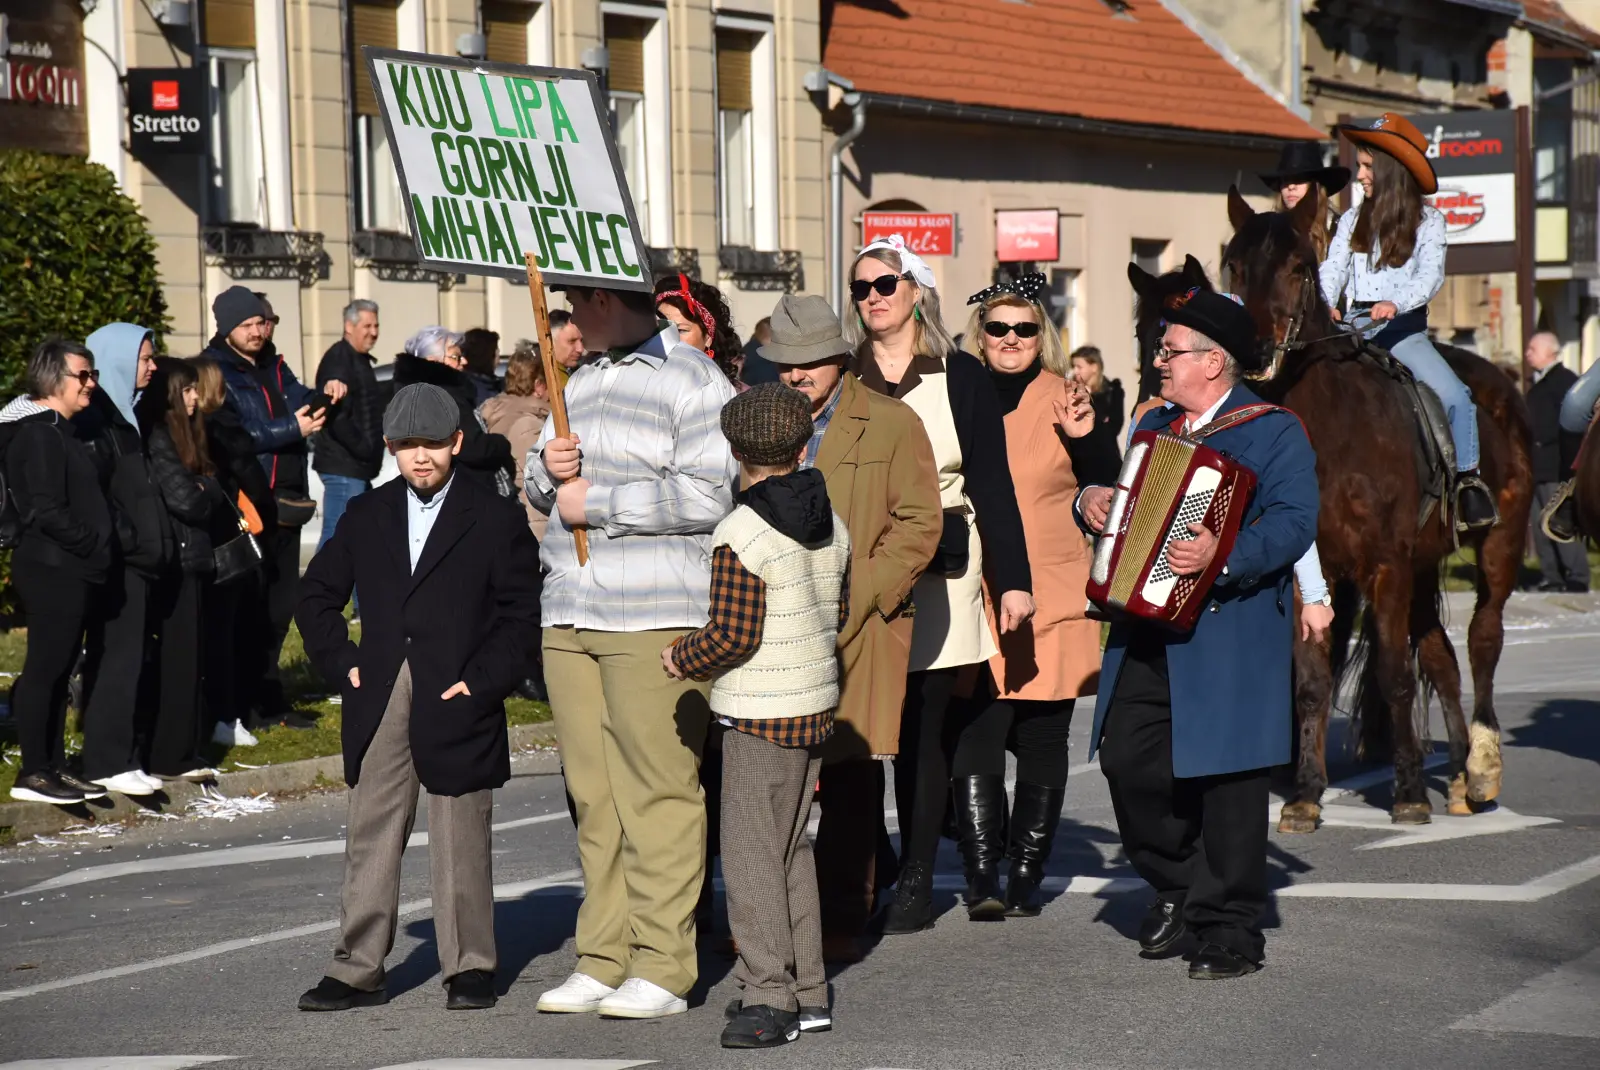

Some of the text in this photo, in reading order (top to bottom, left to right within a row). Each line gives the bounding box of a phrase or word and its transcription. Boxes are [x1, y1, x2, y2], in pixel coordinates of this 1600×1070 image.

[0, 60, 80, 106] room
[386, 63, 579, 143] KUU LIPA
[132, 114, 201, 133] Stretto
[431, 132, 579, 208] GORNJI
[410, 193, 640, 277] MIHALJEVEC
[919, 215, 951, 228] SALON
